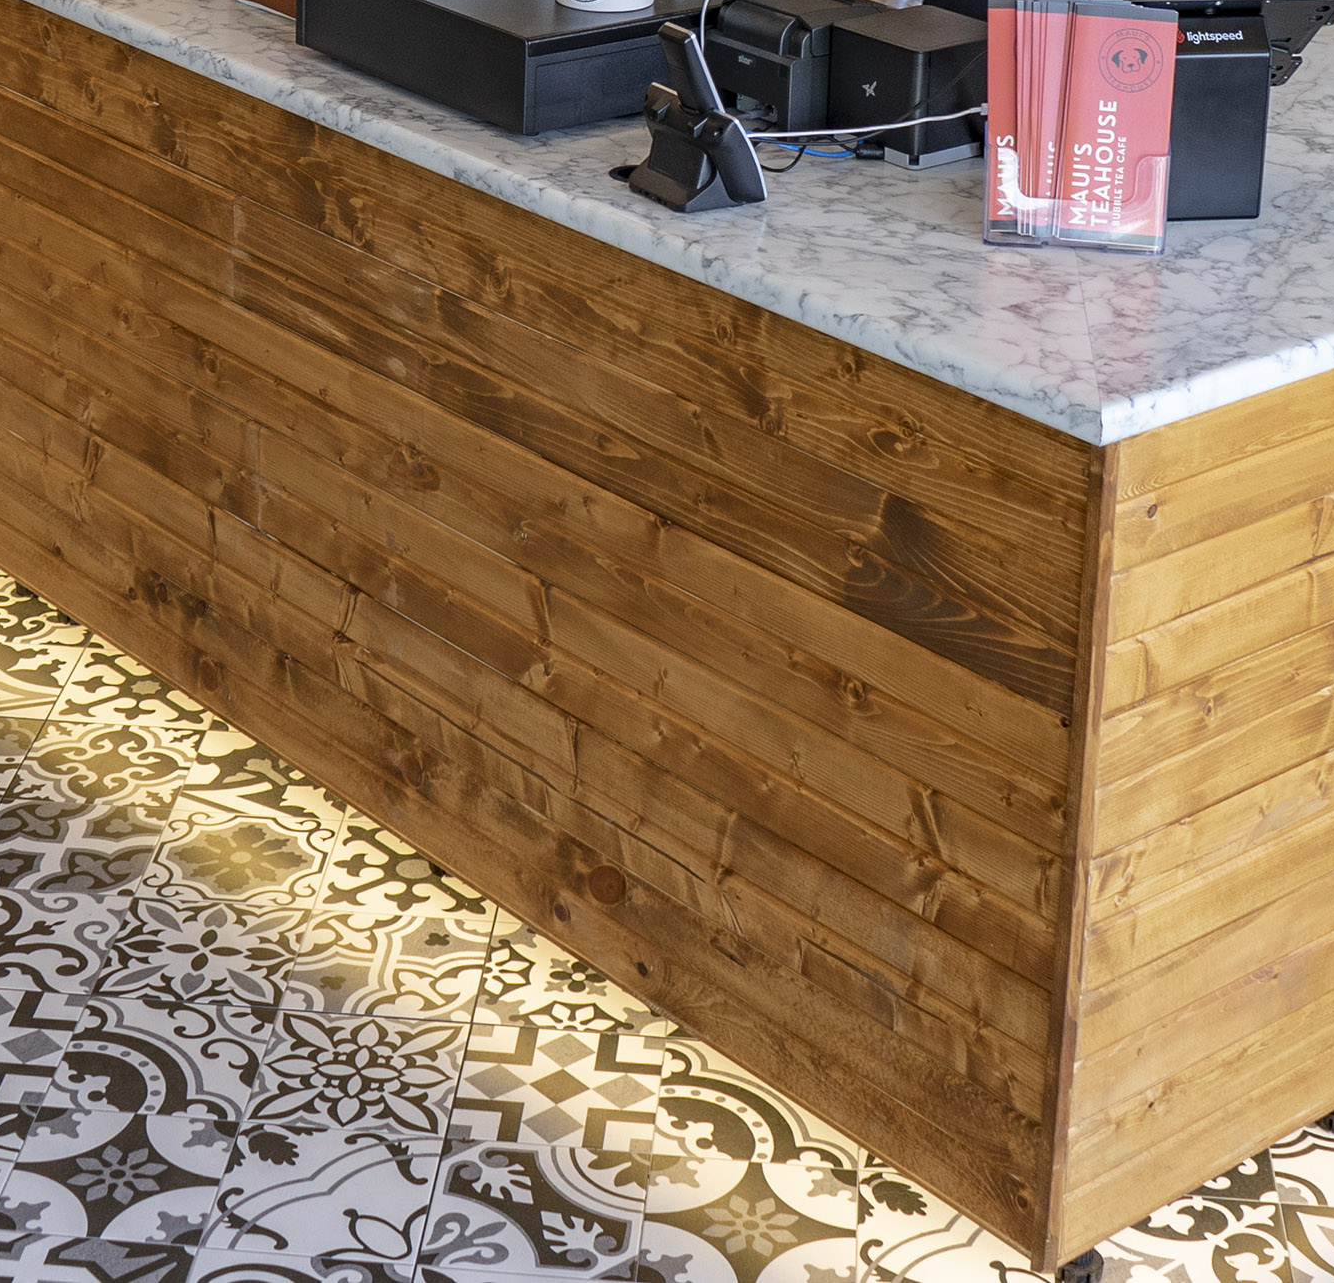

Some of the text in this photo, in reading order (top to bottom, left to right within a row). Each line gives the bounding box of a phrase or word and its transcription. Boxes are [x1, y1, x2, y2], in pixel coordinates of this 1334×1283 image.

[1186, 30, 1244, 45] lightspeed
[1068, 143, 1092, 225] MAUI'S
[1090, 100, 1117, 227] TEAHOUSE
[1111, 136, 1127, 226] BUBBLE TEA CAFE
